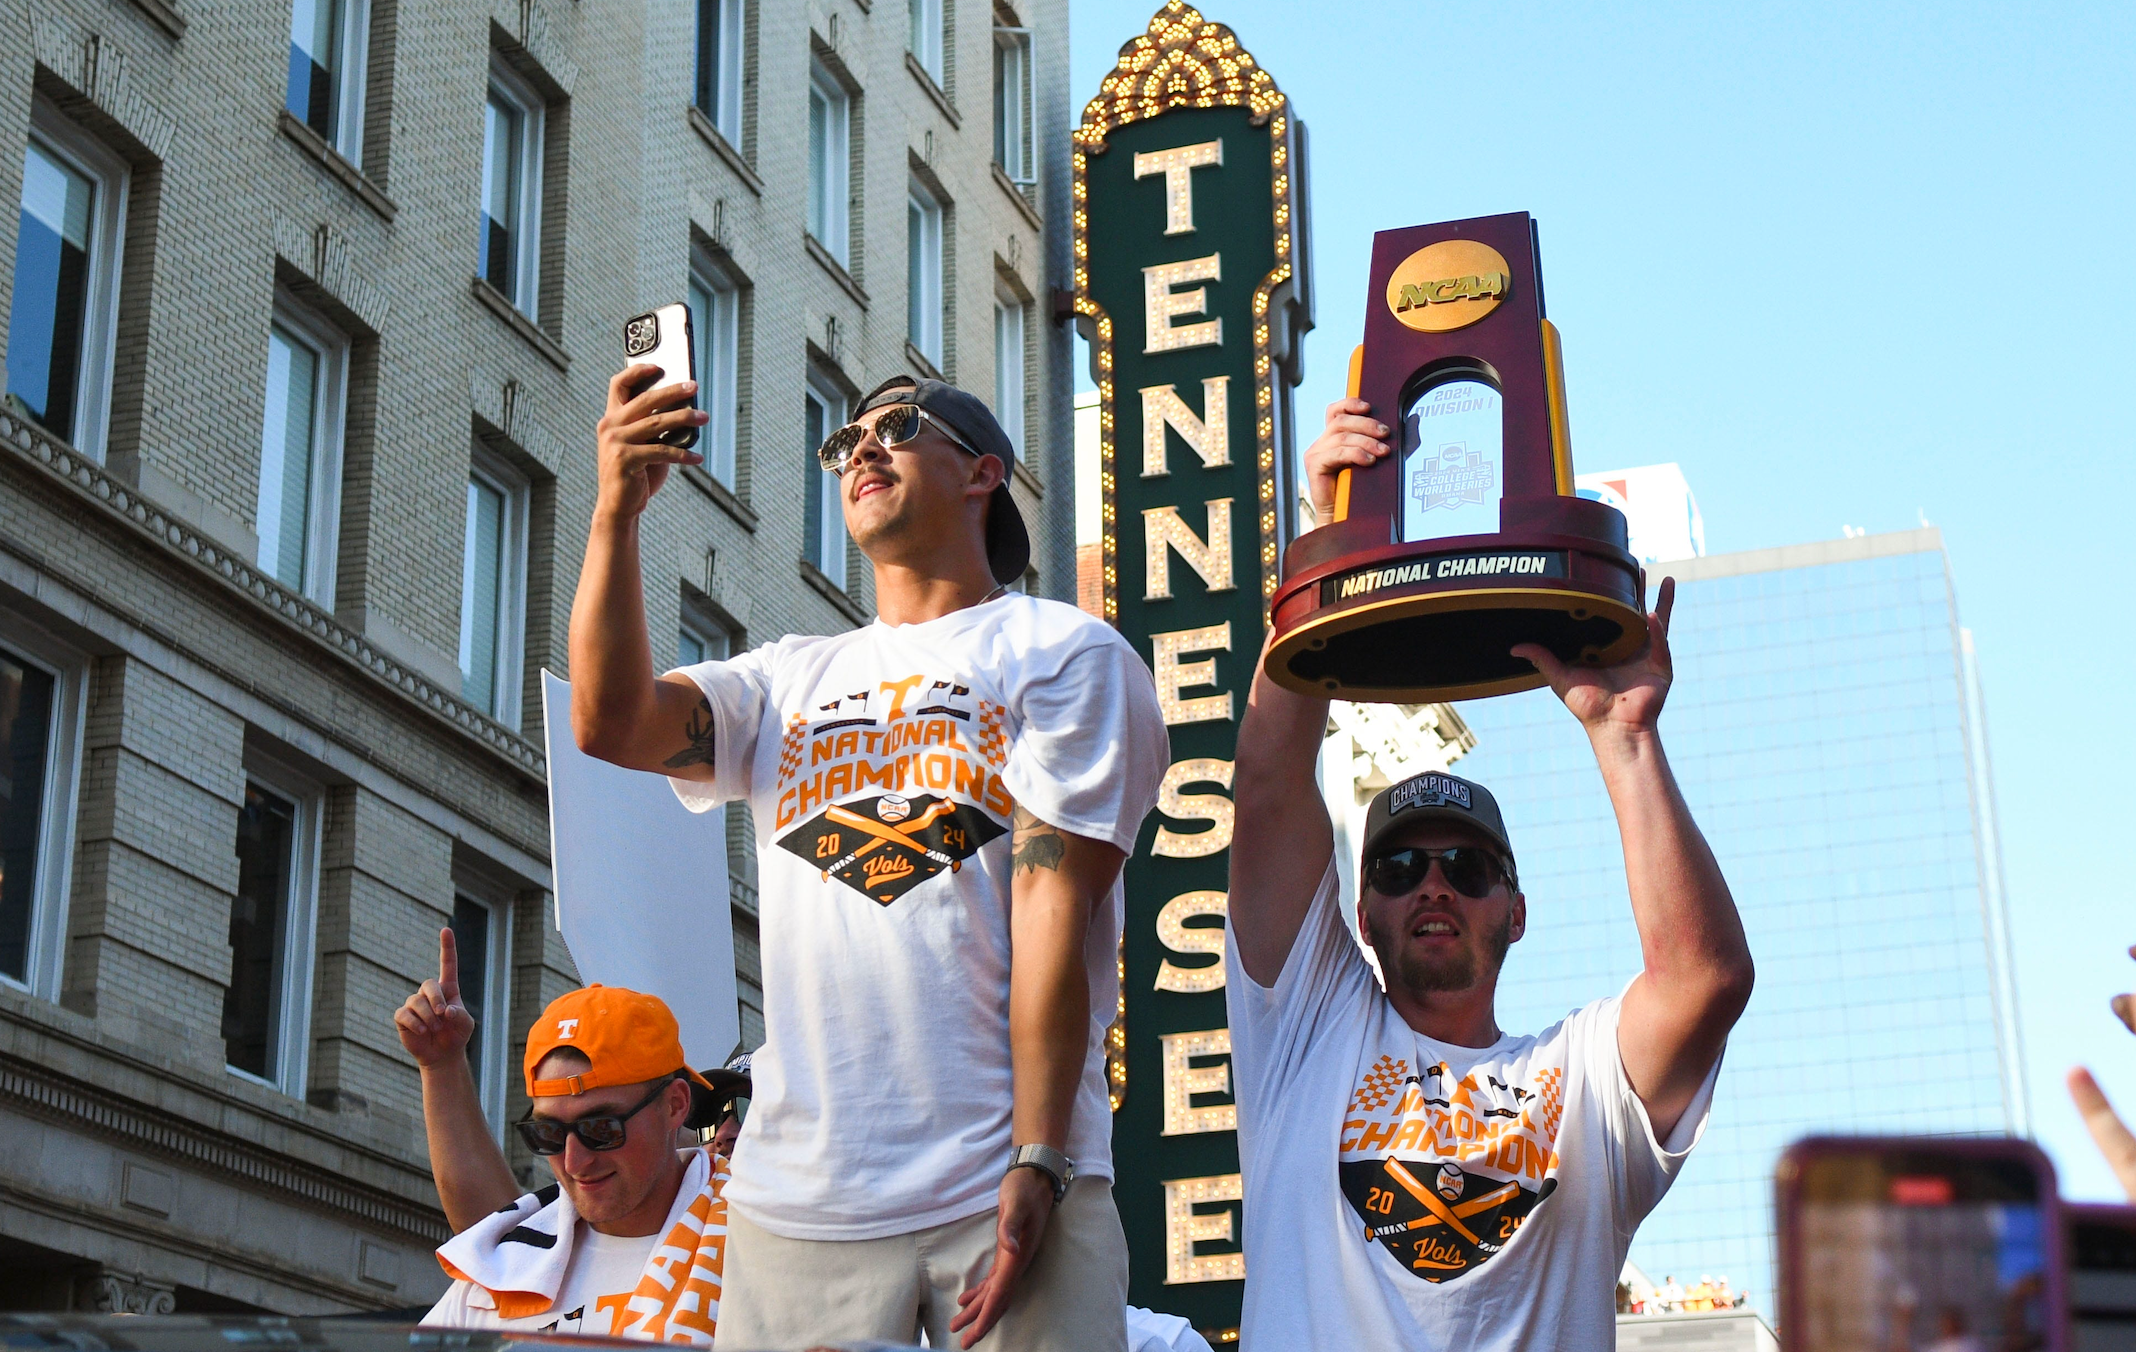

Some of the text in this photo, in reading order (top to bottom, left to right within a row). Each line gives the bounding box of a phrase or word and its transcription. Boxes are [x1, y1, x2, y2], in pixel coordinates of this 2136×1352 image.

[1397, 272, 1507, 313] NCAA
[1416, 398, 1484, 418] DIVISION
[1434, 386, 1472, 402] 2024
[1414, 478, 1492, 497] WORLD SERIES
[1430, 471, 1476, 486] COLLEGE
[1341, 556, 1546, 598] NATIONAL CHAMPION
[1133, 137, 1246, 1286] TENNESSEE
[811, 719, 969, 768] NATIONAL
[776, 752, 1014, 832] CHAMPIONS
[1392, 776, 1468, 807] CHAMPIONS
[880, 803, 908, 814] NCAA
[816, 825, 965, 858] 20 24
[862, 854, 915, 890] Vols
[557, 1018, 579, 1039] T
[1365, 1186, 1395, 1215] 20
[1413, 1237, 1467, 1269] Vols
